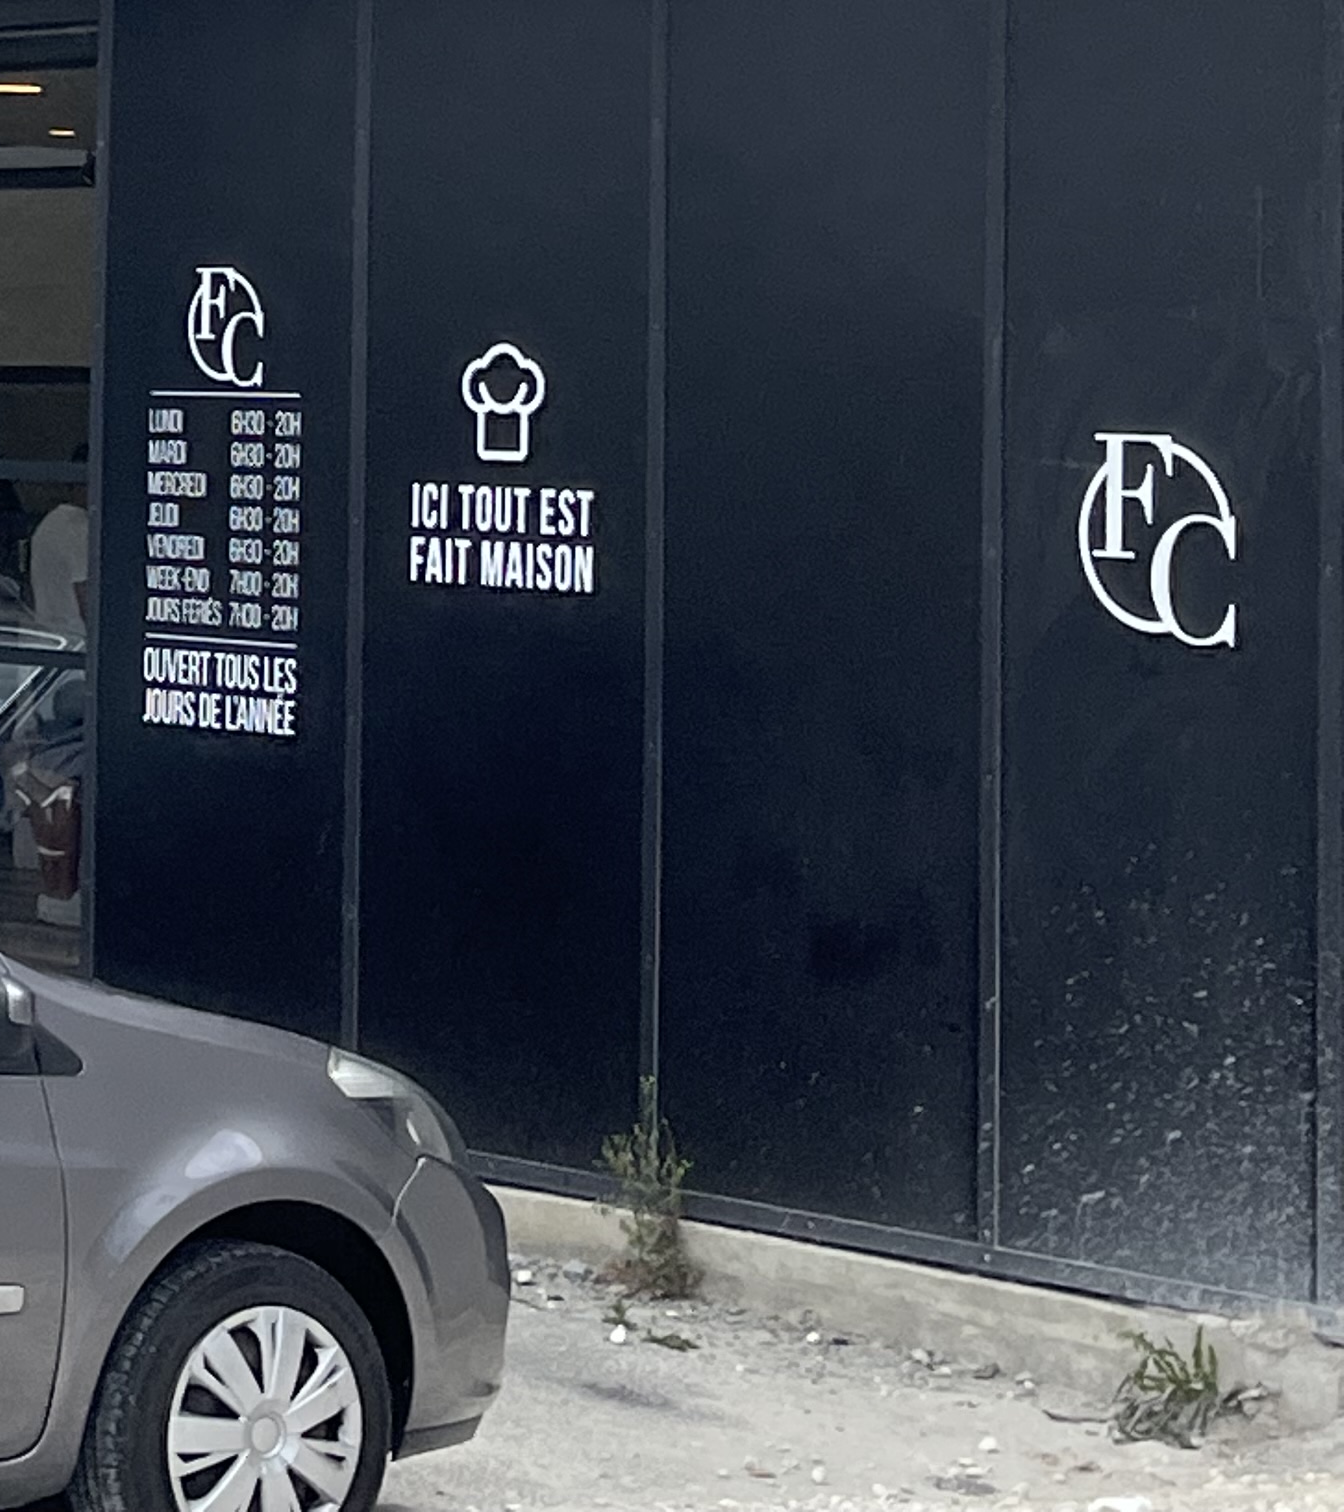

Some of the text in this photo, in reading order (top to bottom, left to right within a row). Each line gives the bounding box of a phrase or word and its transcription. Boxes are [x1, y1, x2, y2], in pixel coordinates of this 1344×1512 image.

[148, 408, 184, 433] LUNDI
[148, 440, 187, 464] MARDI
[147, 471, 207, 498] MERCREDI
[147, 502, 179, 527] JEUDI
[411, 482, 595, 537] ICI TOUT EST
[146, 533, 205, 560] VENDREDI
[410, 536, 595, 594] FAIT MAISON
[145, 597, 181, 623] JOURS
[143, 647, 297, 694] OUVERT TOUS LES
[142, 688, 296, 735] JOURS DE L'ANNÉE
